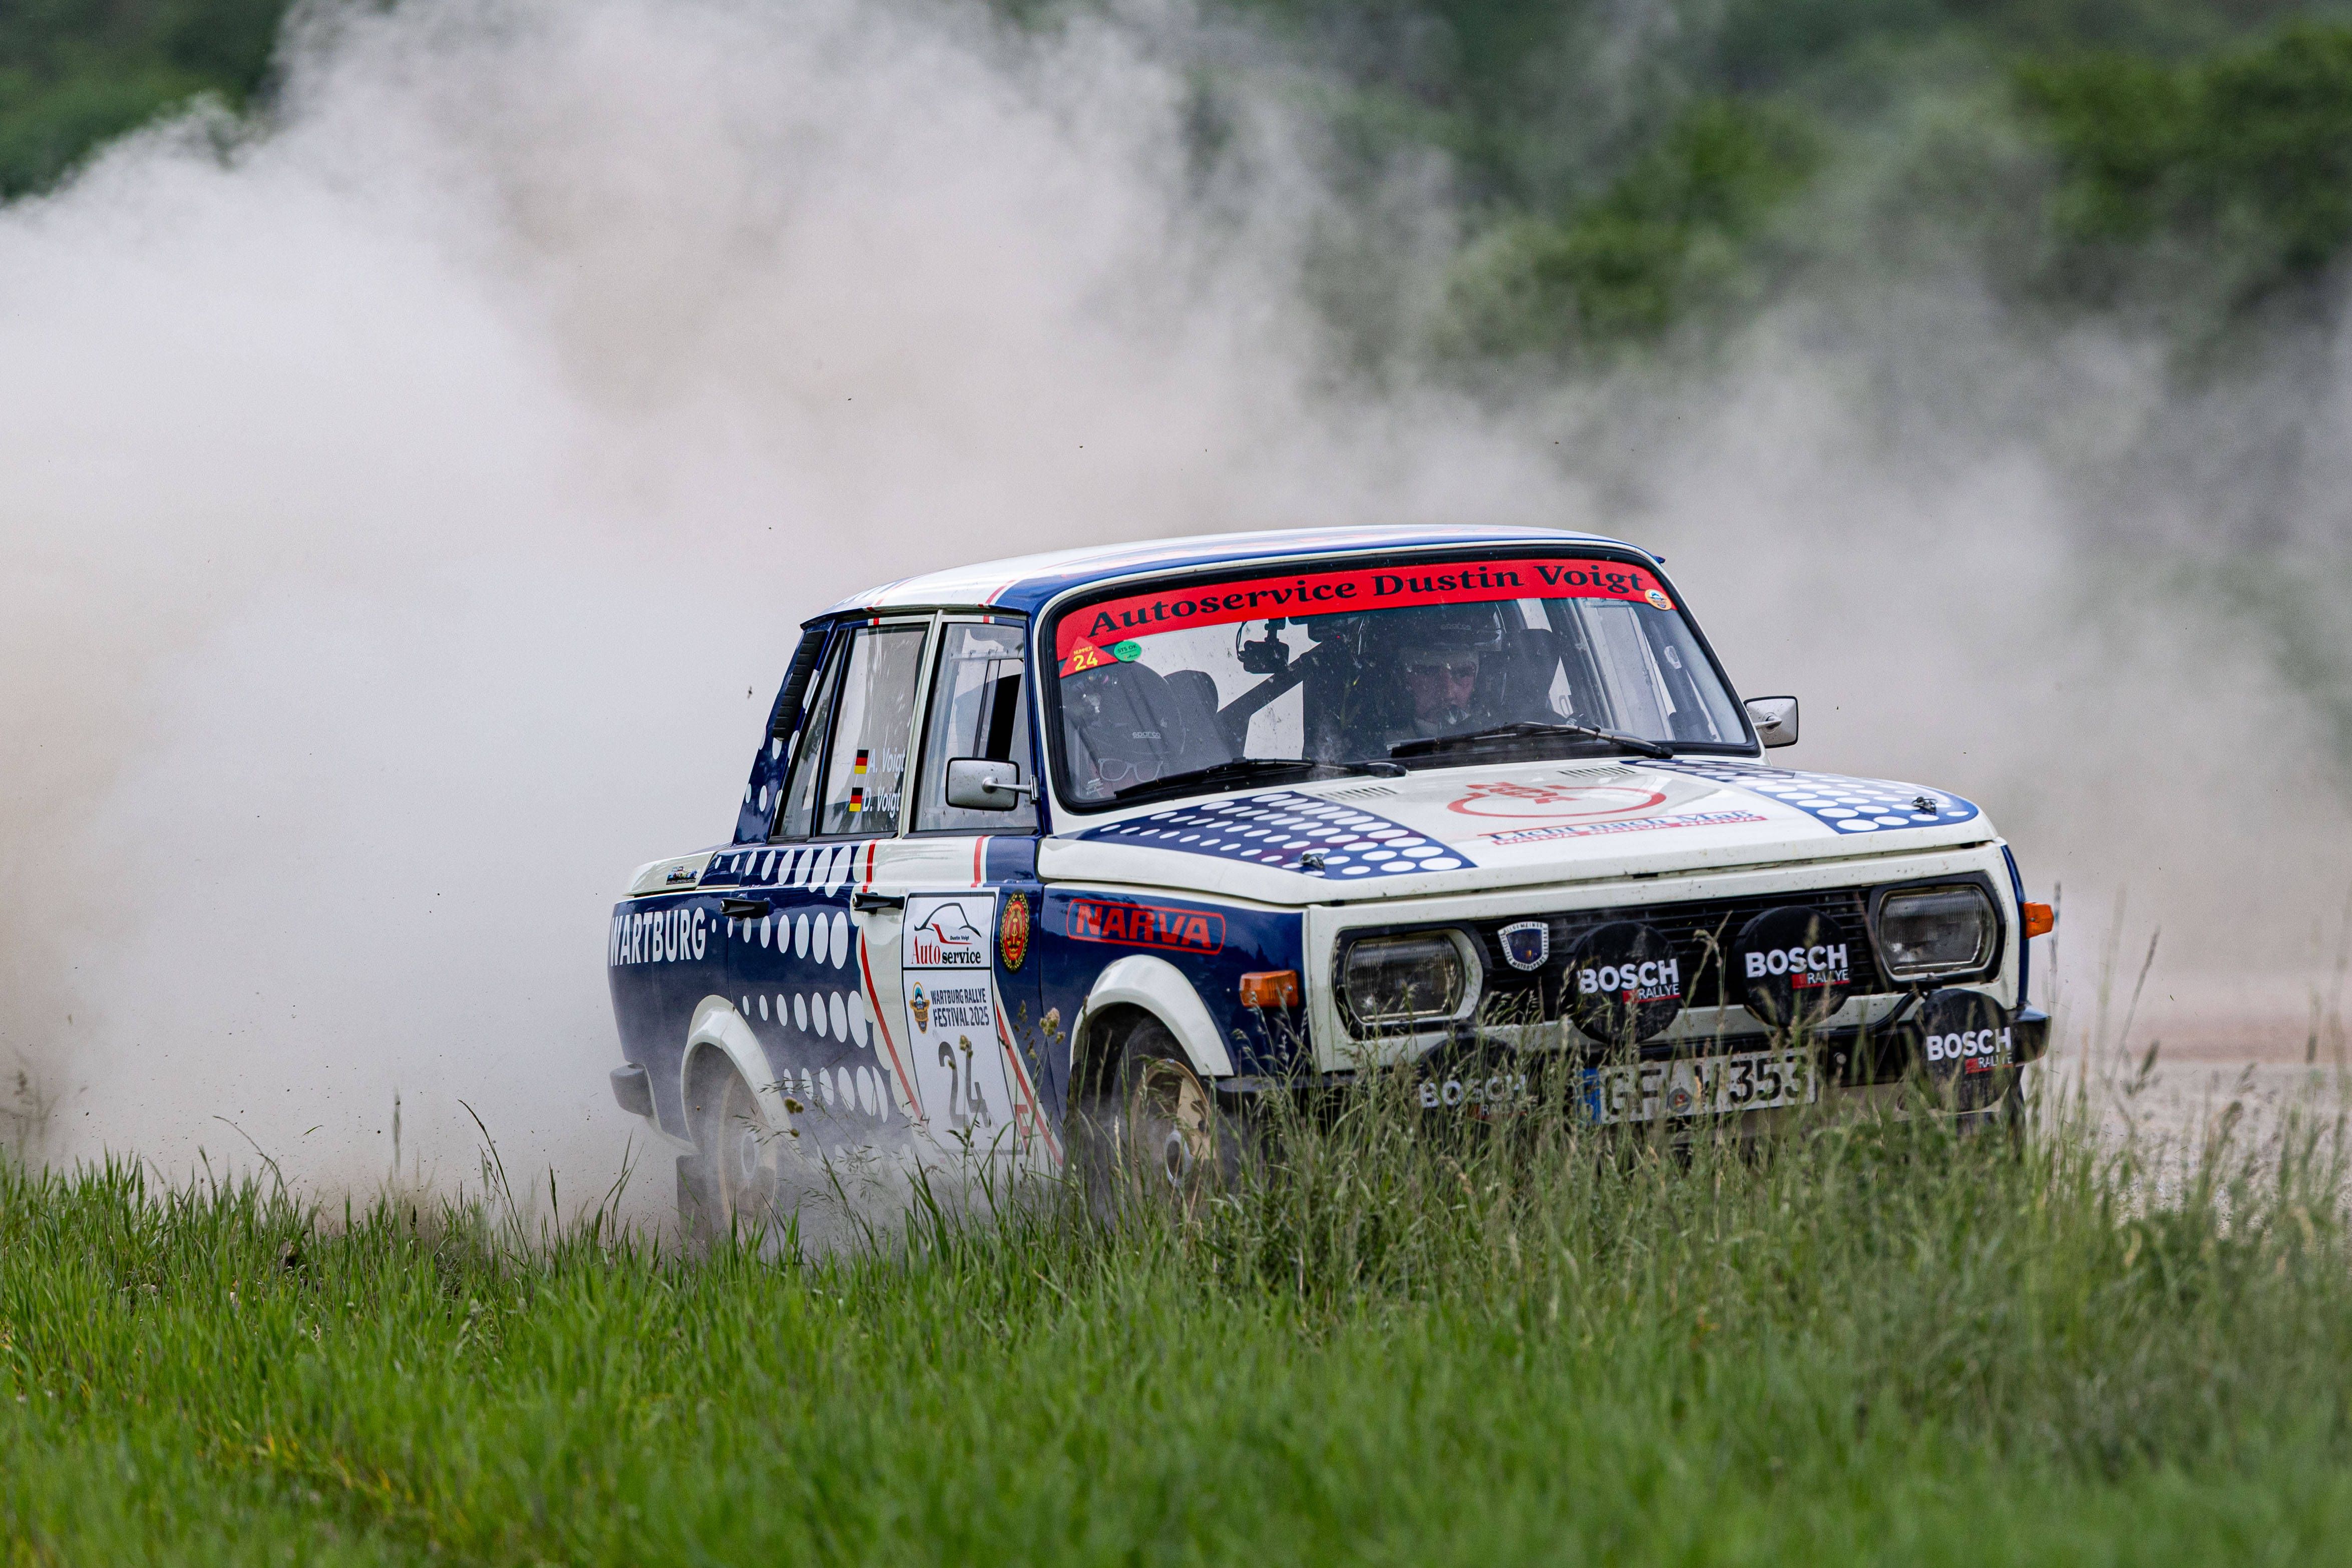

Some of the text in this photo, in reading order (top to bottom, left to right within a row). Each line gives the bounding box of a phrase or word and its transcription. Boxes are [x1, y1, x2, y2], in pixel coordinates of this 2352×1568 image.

[1087, 564, 1646, 638] Autoservice Dustin Voigt
[1073, 646, 1092, 655] NUMMER
[1073, 651, 1098, 671] 24
[867, 747, 906, 779] A. Voigt
[863, 786, 901, 819] D. Voigt
[1490, 826, 1579, 840] Licht
[1589, 819, 1667, 830] nach
[610, 907, 706, 967] WARTBURG
[1076, 905, 1212, 948] NARVA
[1577, 958, 1680, 994] BOSCH
[1745, 943, 1848, 978] BOSCH
[930, 988, 987, 1005] WARTBURG RALLYE
[1638, 983, 1680, 1000] RALLYE
[932, 1006, 990, 1027] FESTIVAL 2025
[1926, 1026, 2012, 1061] BOSCH
[938, 1041, 992, 1128] 24
[1729, 1054, 1809, 1103] 353
